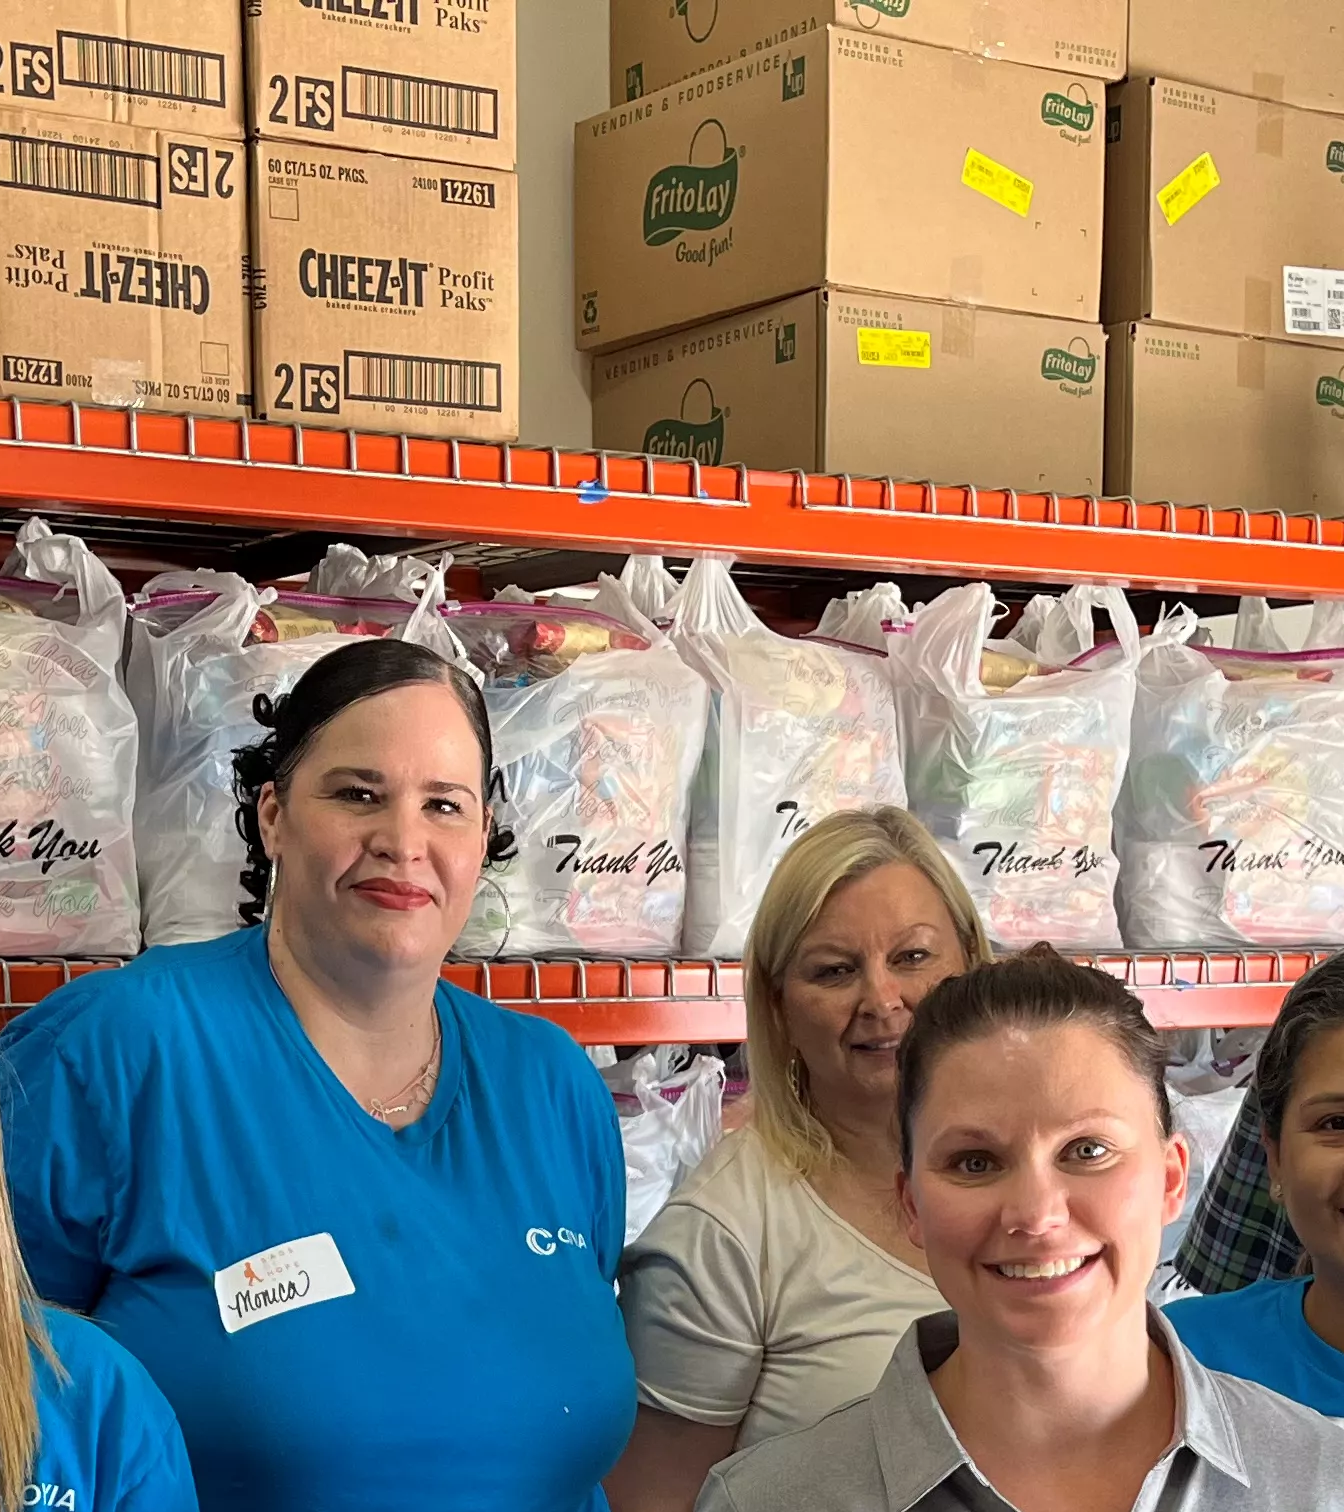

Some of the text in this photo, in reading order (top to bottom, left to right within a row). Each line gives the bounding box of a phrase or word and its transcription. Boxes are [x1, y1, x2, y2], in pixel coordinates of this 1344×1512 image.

[321, 13, 346, 23] baked
[375, 20, 411, 34] crackers
[435, 7, 481, 34] Paks
[837, 37, 890, 54] VENDING
[837, 47, 903, 68] FOODSERVICE
[14, 48, 52, 95] FS
[269, 74, 332, 127] 2 FS
[592, 102, 653, 137] VENDING
[678, 53, 780, 105] FOODSERVICE
[172, 149, 234, 199] 2 FS
[268, 158, 282, 174] 60
[339, 168, 368, 185] PKGS.
[412, 177, 492, 206] 24100 12261
[15, 244, 66, 269] Paks
[676, 227, 733, 267] Good fun!
[5, 266, 69, 293] Profit
[438, 267, 495, 291] Profit
[326, 300, 350, 311] baked
[440, 289, 487, 311] Paks
[838, 306, 889, 319] VENDING
[605, 319, 774, 380] VENDING FOODSERVICE
[6, 357, 60, 385] 12261
[217, 389, 230, 403] 60
[274, 363, 338, 411] 2 FS
[28, 818, 102, 875] You
[1198, 839, 1291, 873] Thank
[23, 1482, 76, 1512] OVIA
